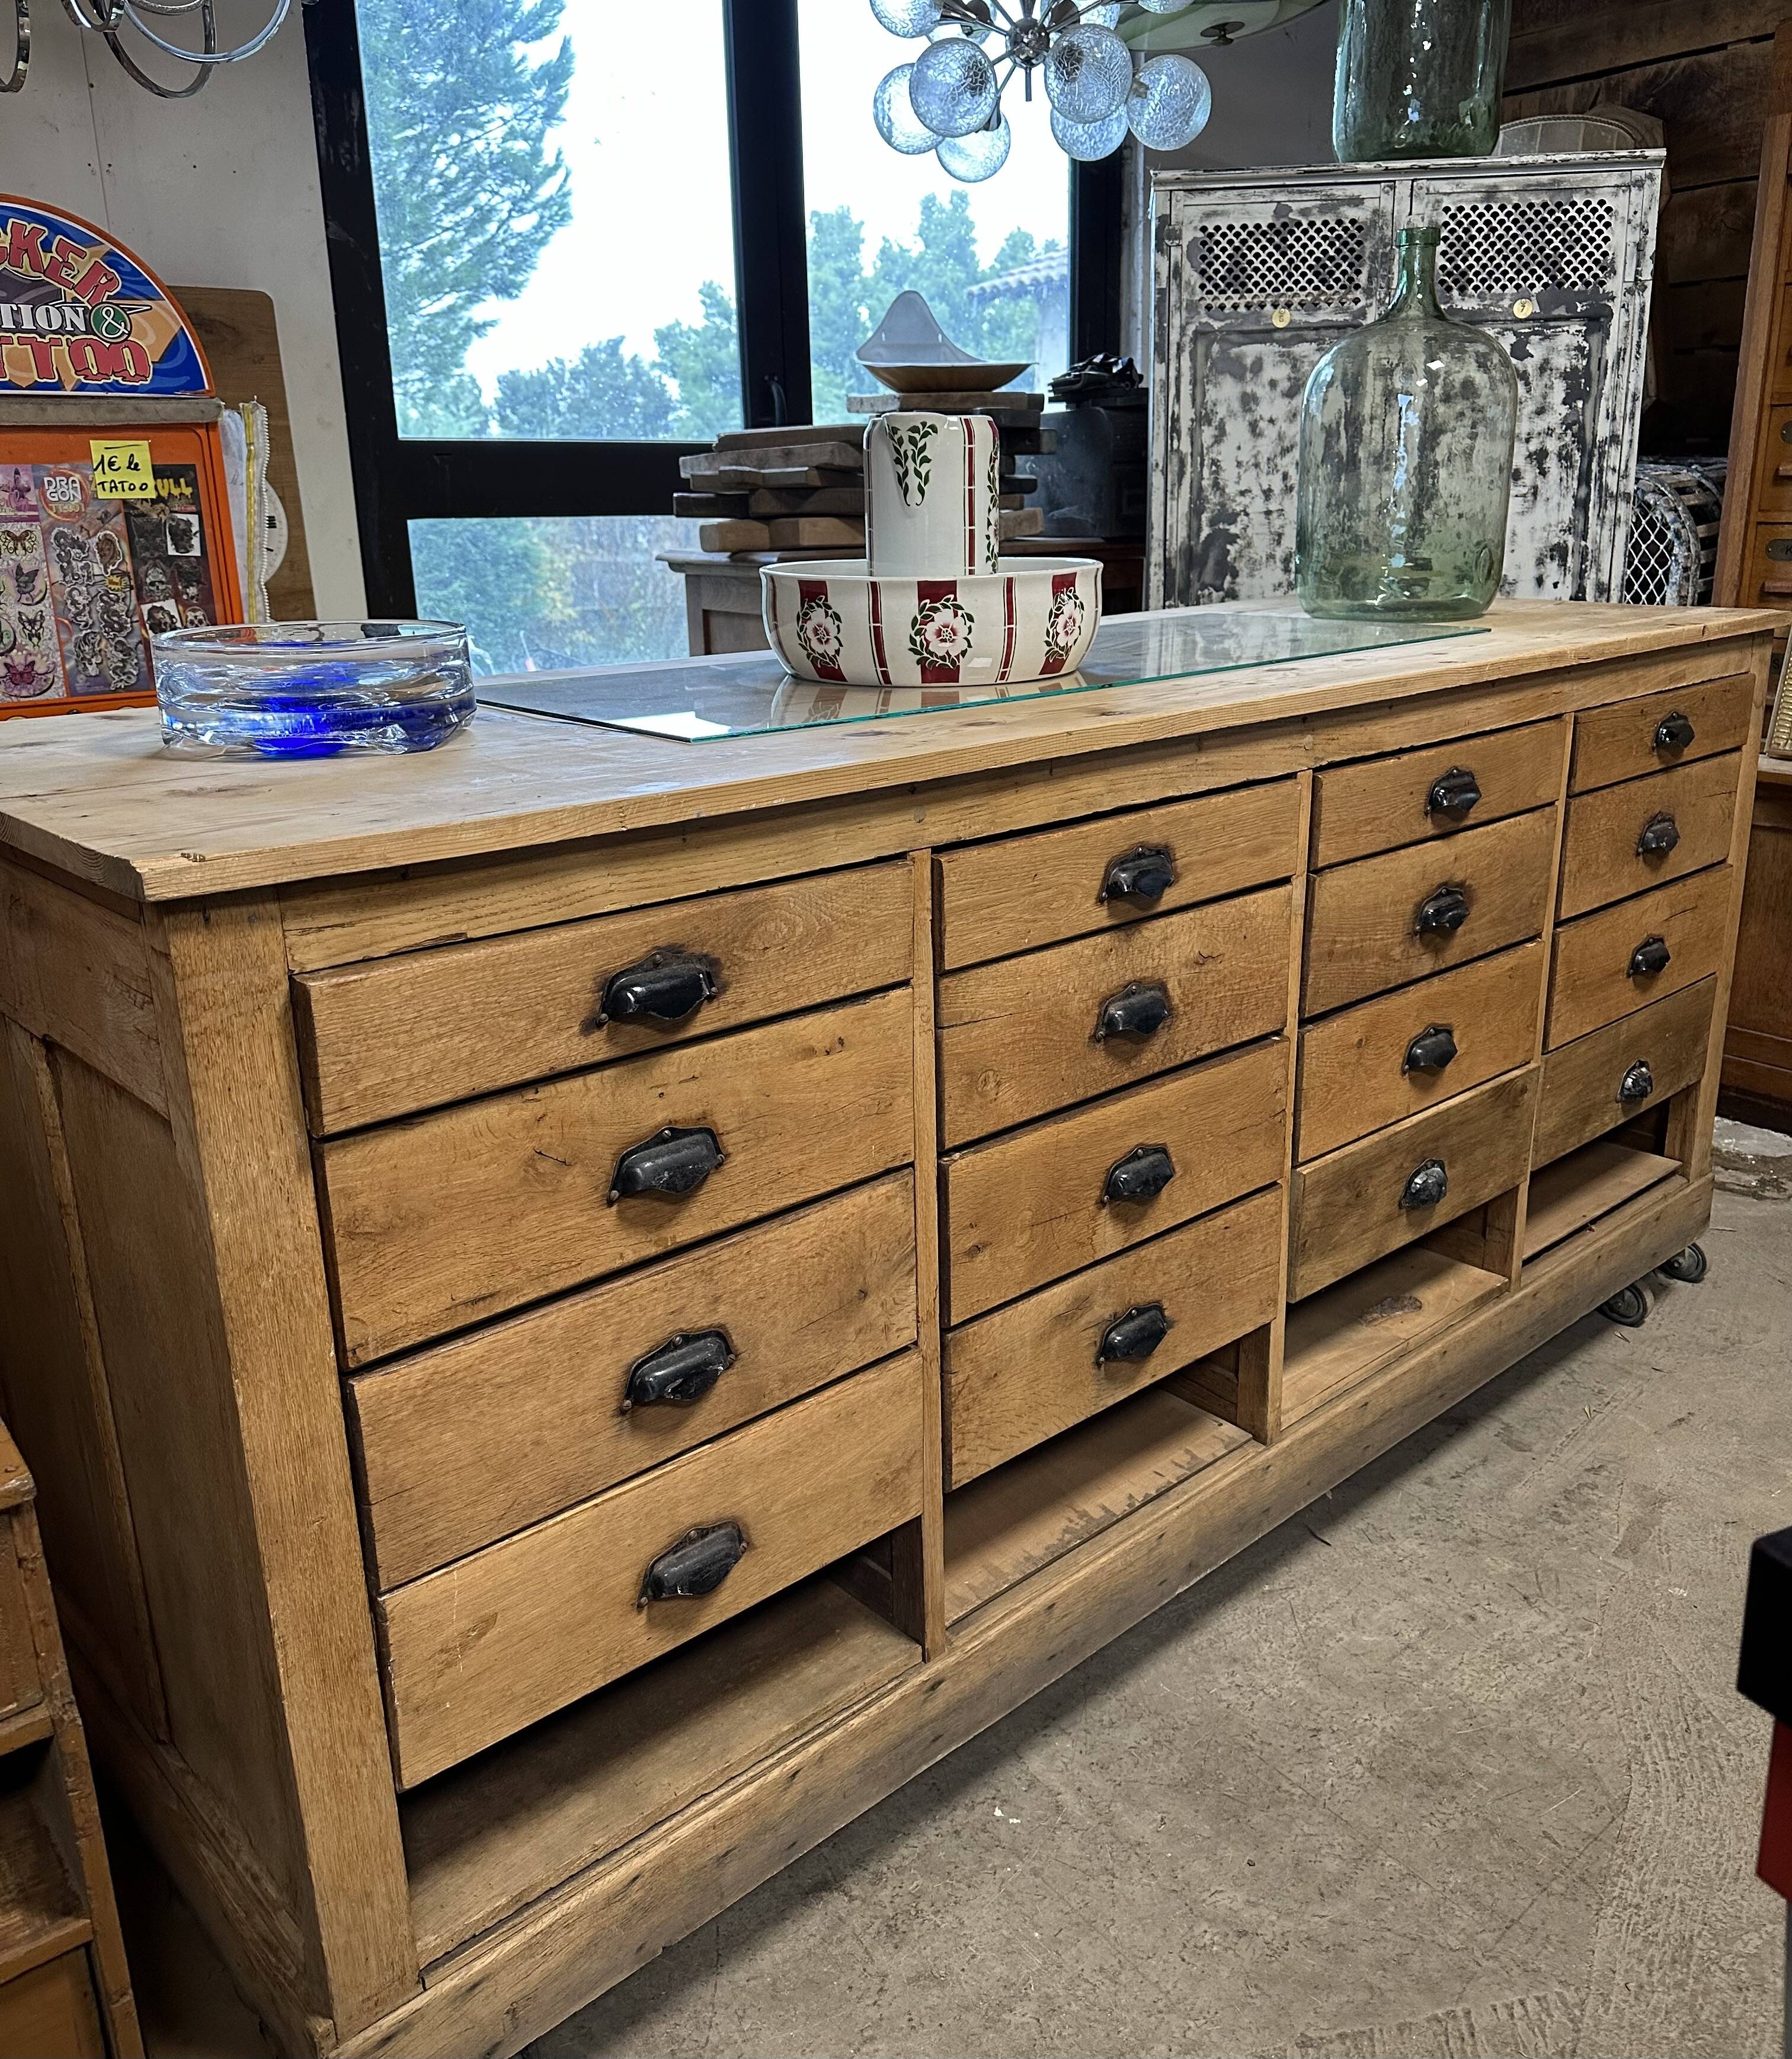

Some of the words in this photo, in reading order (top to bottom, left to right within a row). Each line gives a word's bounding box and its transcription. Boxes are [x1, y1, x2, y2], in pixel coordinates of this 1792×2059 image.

[0, 219, 121, 307] KER
[100, 306, 130, 338] &
[97, 479, 148, 493] TATOO
[155, 478, 193, 498] ULL
